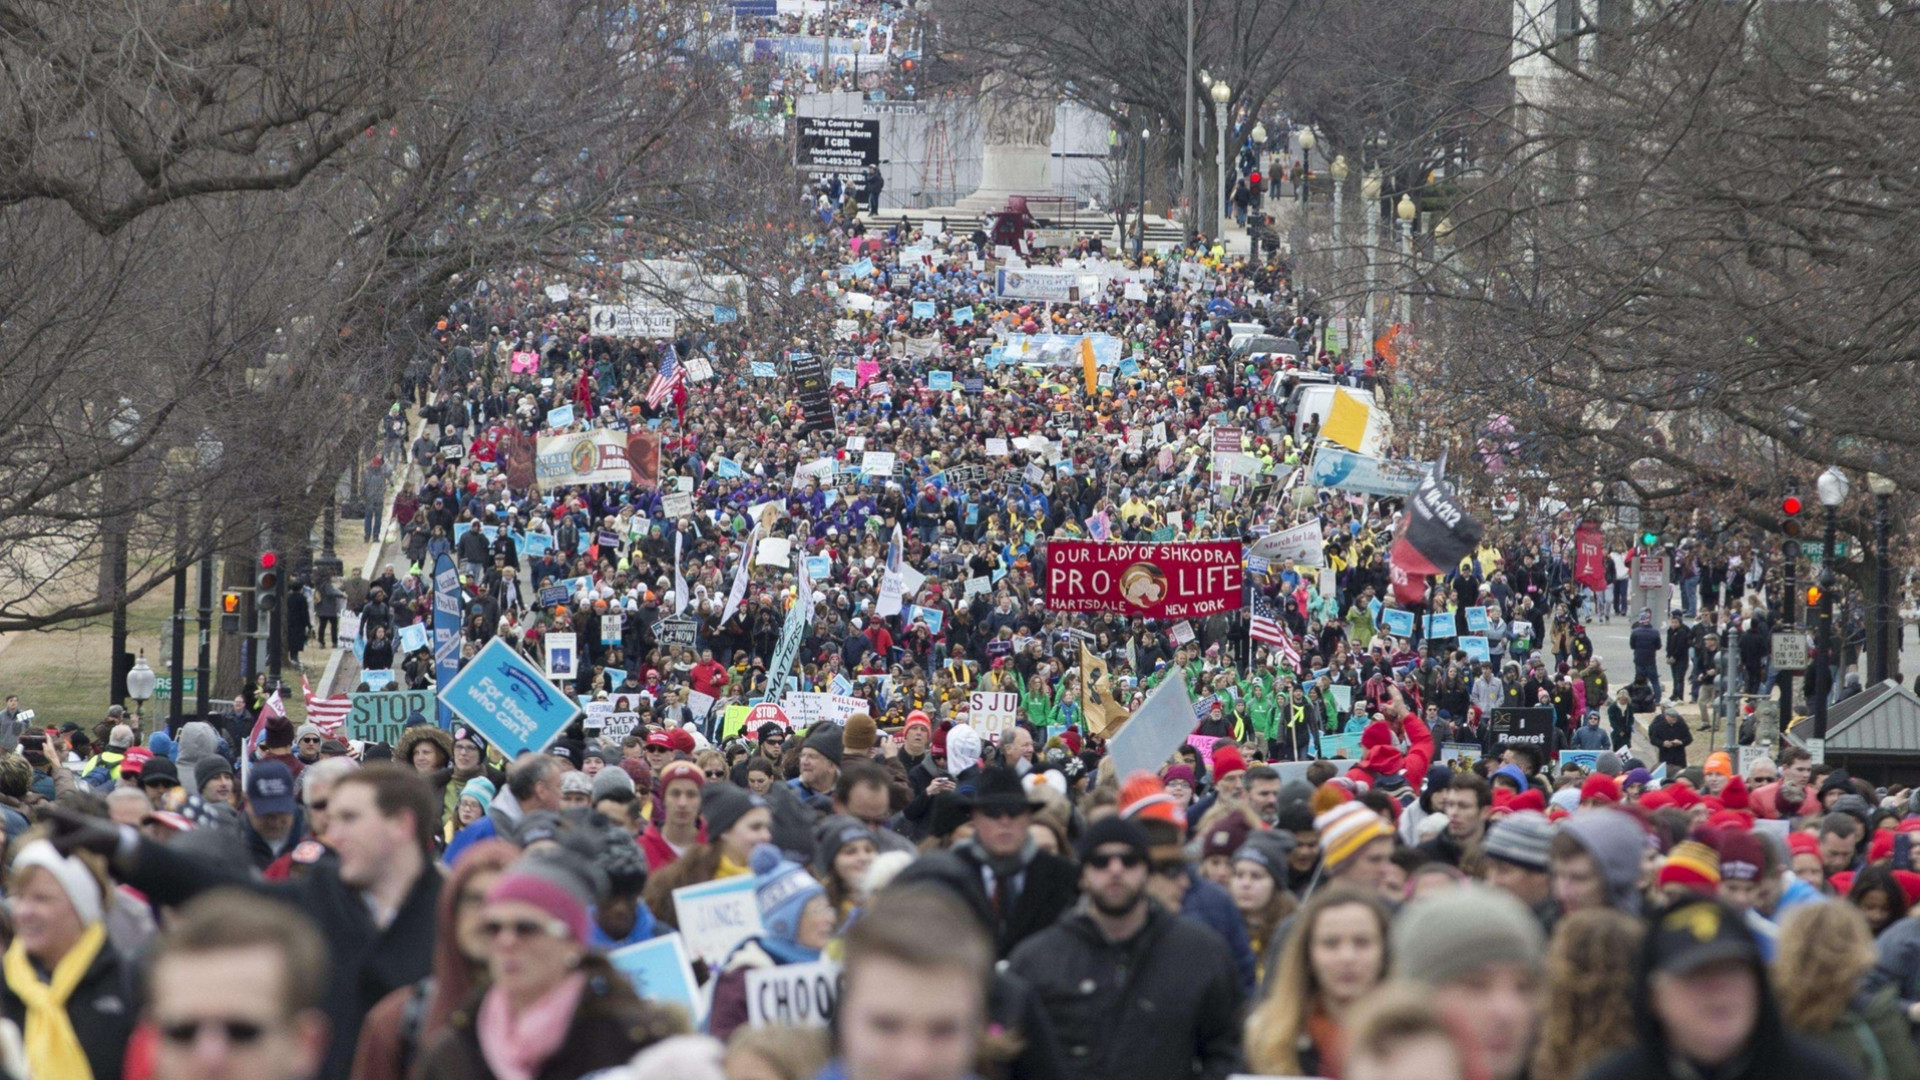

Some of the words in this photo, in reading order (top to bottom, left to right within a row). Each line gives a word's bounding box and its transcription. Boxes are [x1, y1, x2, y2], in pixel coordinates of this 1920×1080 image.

[812, 119, 827, 128] The
[827, 120, 852, 128] Center
[845, 130, 872, 138] Reform
[830, 138, 851, 147] CBR
[654, 317, 672, 327] LIFE
[1264, 536, 1291, 549] March
[1292, 534, 1302, 543] for
[1801, 543, 1824, 554] FIRS
[1055, 549, 1090, 564] OUR
[1098, 545, 1136, 562] LADY
[1139, 546, 1156, 560] OF
[1160, 546, 1236, 564] SHKODRA
[1051, 568, 1110, 595] PRO
[1178, 565, 1242, 596] LIFE
[1051, 598, 1126, 612] HARTSDALE
[1165, 604, 1188, 616] NEW
[1192, 599, 1225, 613] YORK
[674, 631, 694, 641] NOW
[1779, 643, 1800, 651] TURN
[1775, 651, 1786, 659] ON
[1788, 651, 1804, 659] RED
[478, 675, 504, 700] For
[502, 693, 539, 733] those
[831, 696, 867, 708] KILLING
[971, 693, 1016, 712] SJU
[353, 693, 426, 725] STOP
[467, 684, 498, 715] who
[496, 705, 531, 744] can't.
[755, 707, 778, 718] STOP
[837, 705, 855, 713] NOT
[604, 716, 640, 726] EVERY
[602, 725, 630, 735] CHILD
[1189, 737, 1212, 748] LOVE
[1498, 733, 1545, 744] Regret
[758, 975, 834, 1024] CHOO
